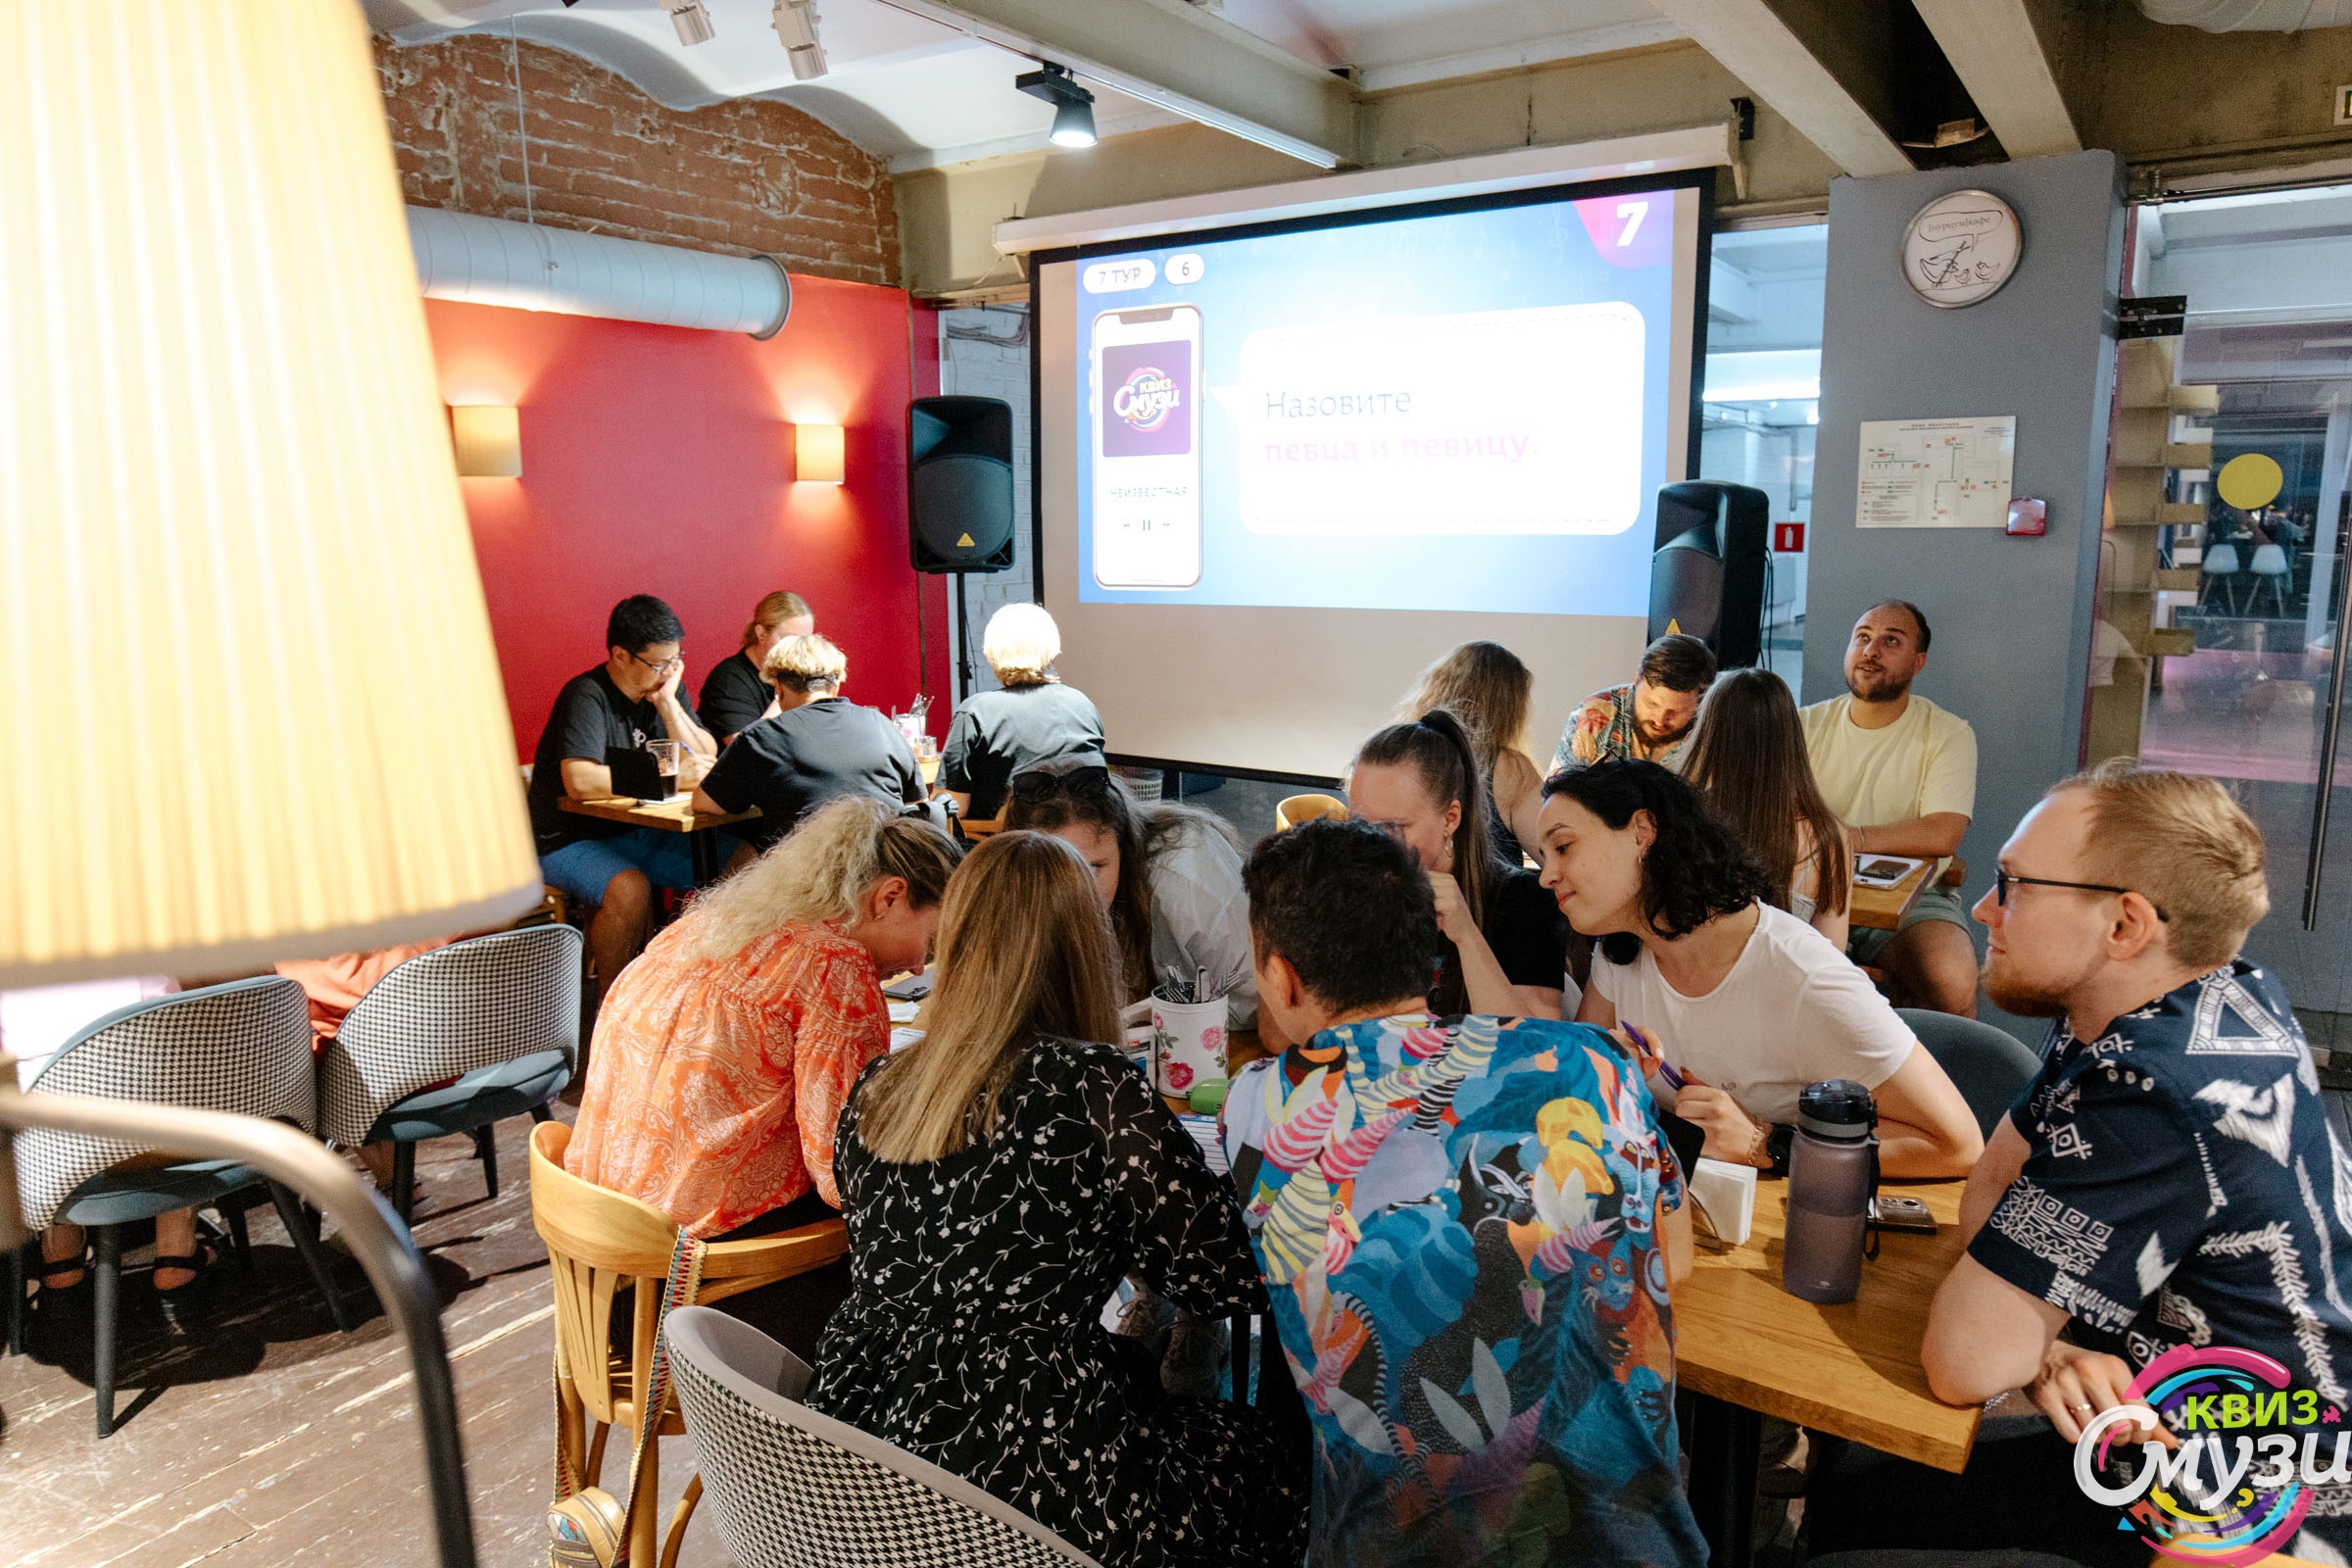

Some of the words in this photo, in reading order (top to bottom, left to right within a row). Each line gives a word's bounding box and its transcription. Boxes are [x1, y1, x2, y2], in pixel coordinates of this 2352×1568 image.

[1616, 201, 1649, 247] 7
[1098, 270, 1107, 285] 7
[1111, 267, 1142, 283] ТУР
[1181, 261, 1191, 276] 6
[1139, 377, 1173, 393] КВИЗ
[1113, 385, 1181, 417] Смузи
[1264, 390, 1412, 419] Назовите
[1264, 440, 1359, 464] певца
[1368, 438, 1390, 461] и
[1399, 433, 1539, 464] певицу.
